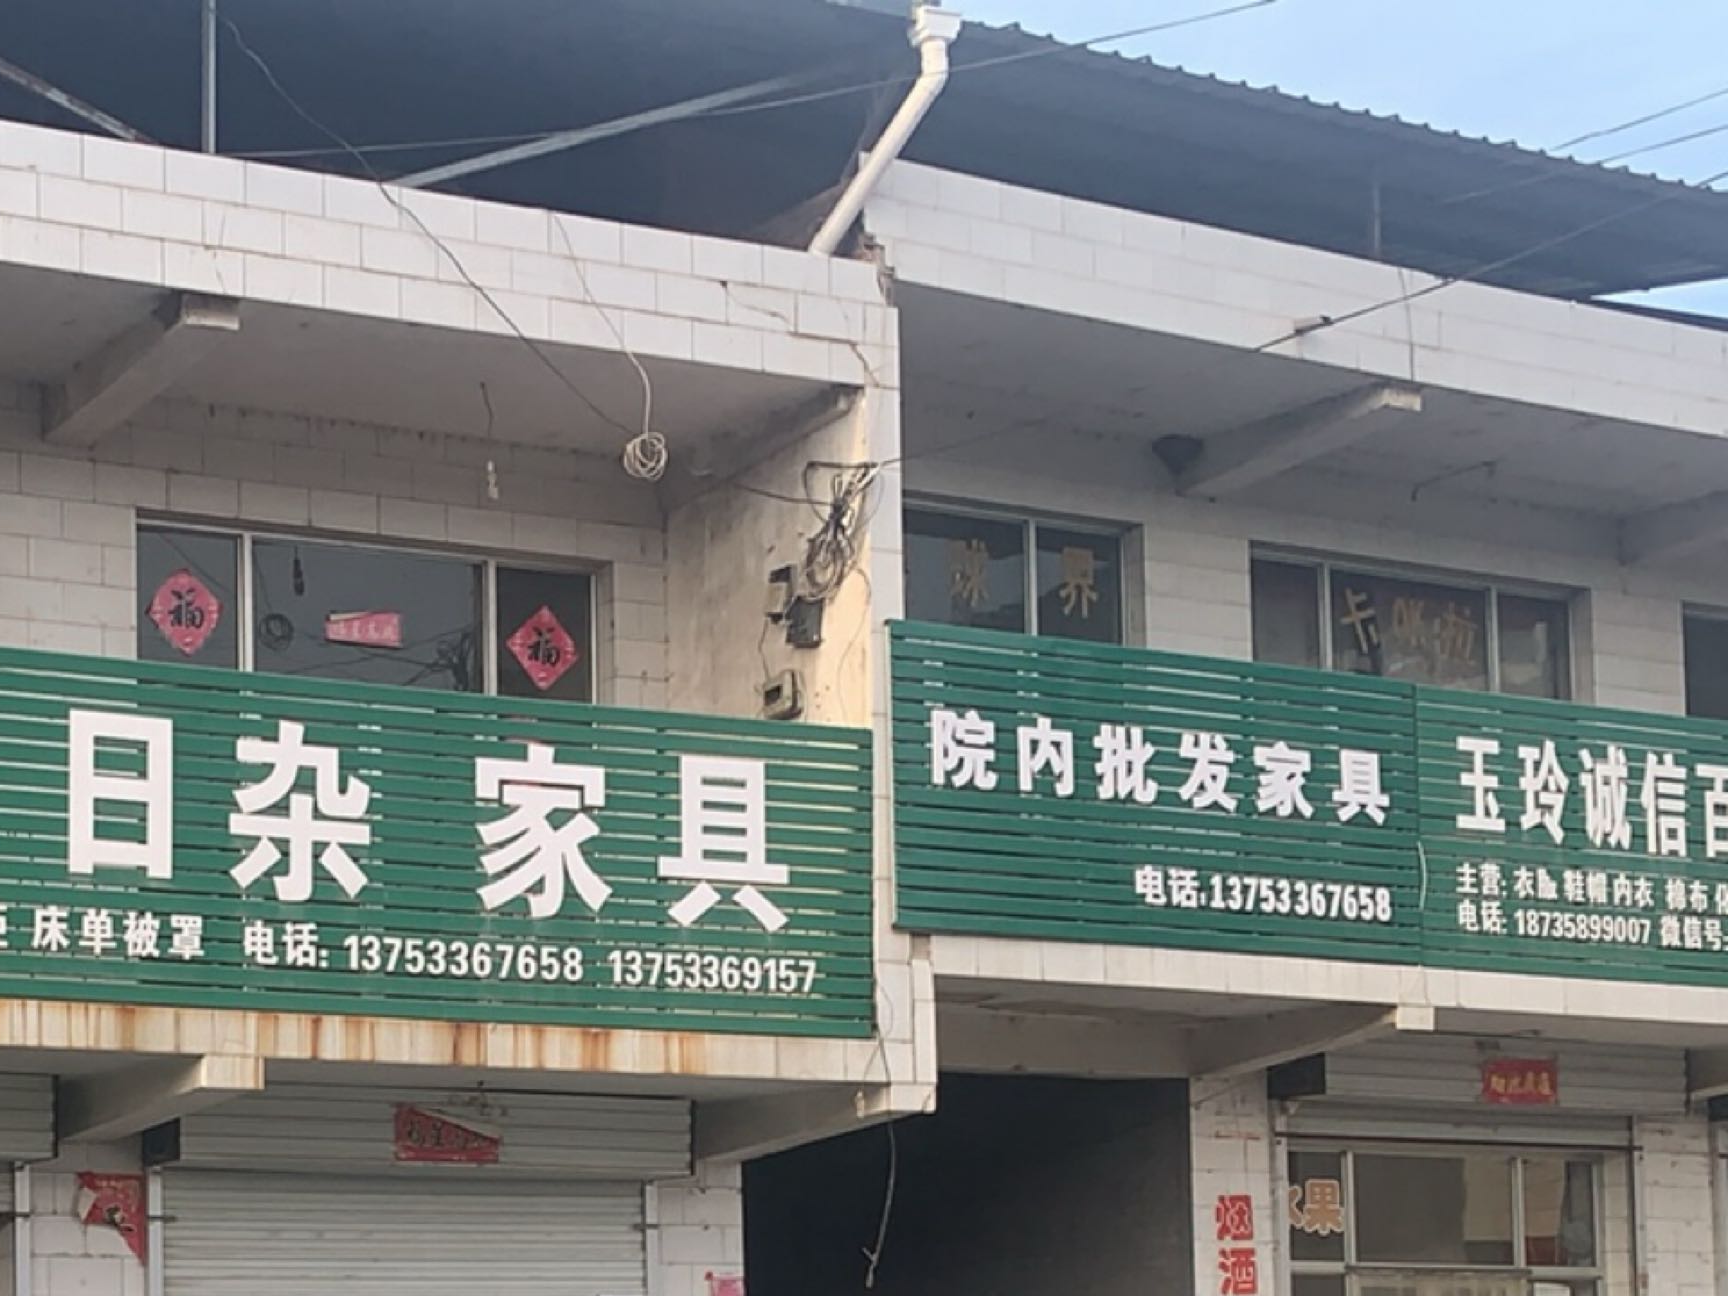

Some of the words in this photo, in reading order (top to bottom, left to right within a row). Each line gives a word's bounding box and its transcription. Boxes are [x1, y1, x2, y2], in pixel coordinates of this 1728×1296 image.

[167, 587, 207, 630] 福
[526, 624, 562, 667] 福
[929, 709, 1391, 827] 院内批发家具
[32, 904, 206, 961] 床单被罩
[1513, 908, 1651, 945] 18735899007
[343, 934, 585, 983] 13753367658
[607, 949, 818, 994] 13753369157
